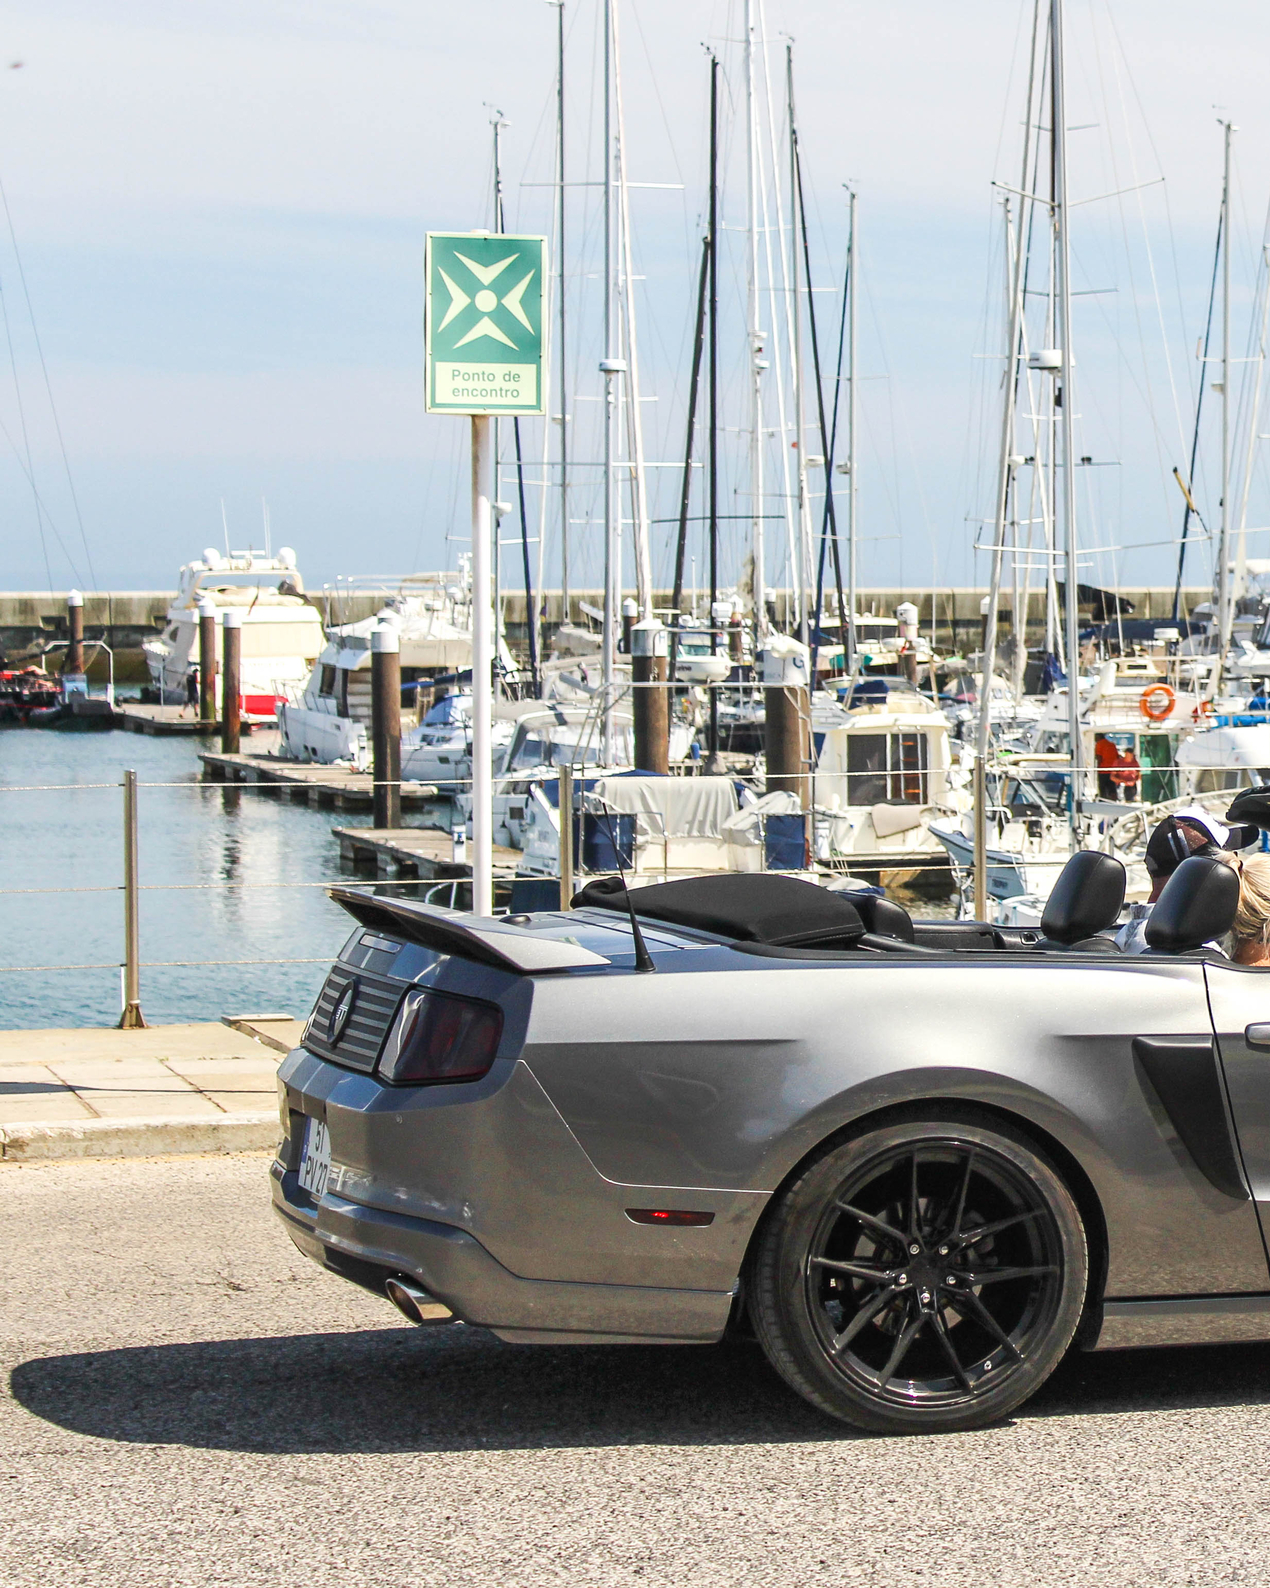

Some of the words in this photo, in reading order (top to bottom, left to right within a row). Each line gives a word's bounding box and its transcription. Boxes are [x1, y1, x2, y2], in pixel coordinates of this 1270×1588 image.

[452, 369, 496, 382] Ponto
[503, 370, 521, 382] de
[452, 386, 520, 398] encontro
[315, 1120, 326, 1155] 51
[315, 1161, 328, 1196] 27
